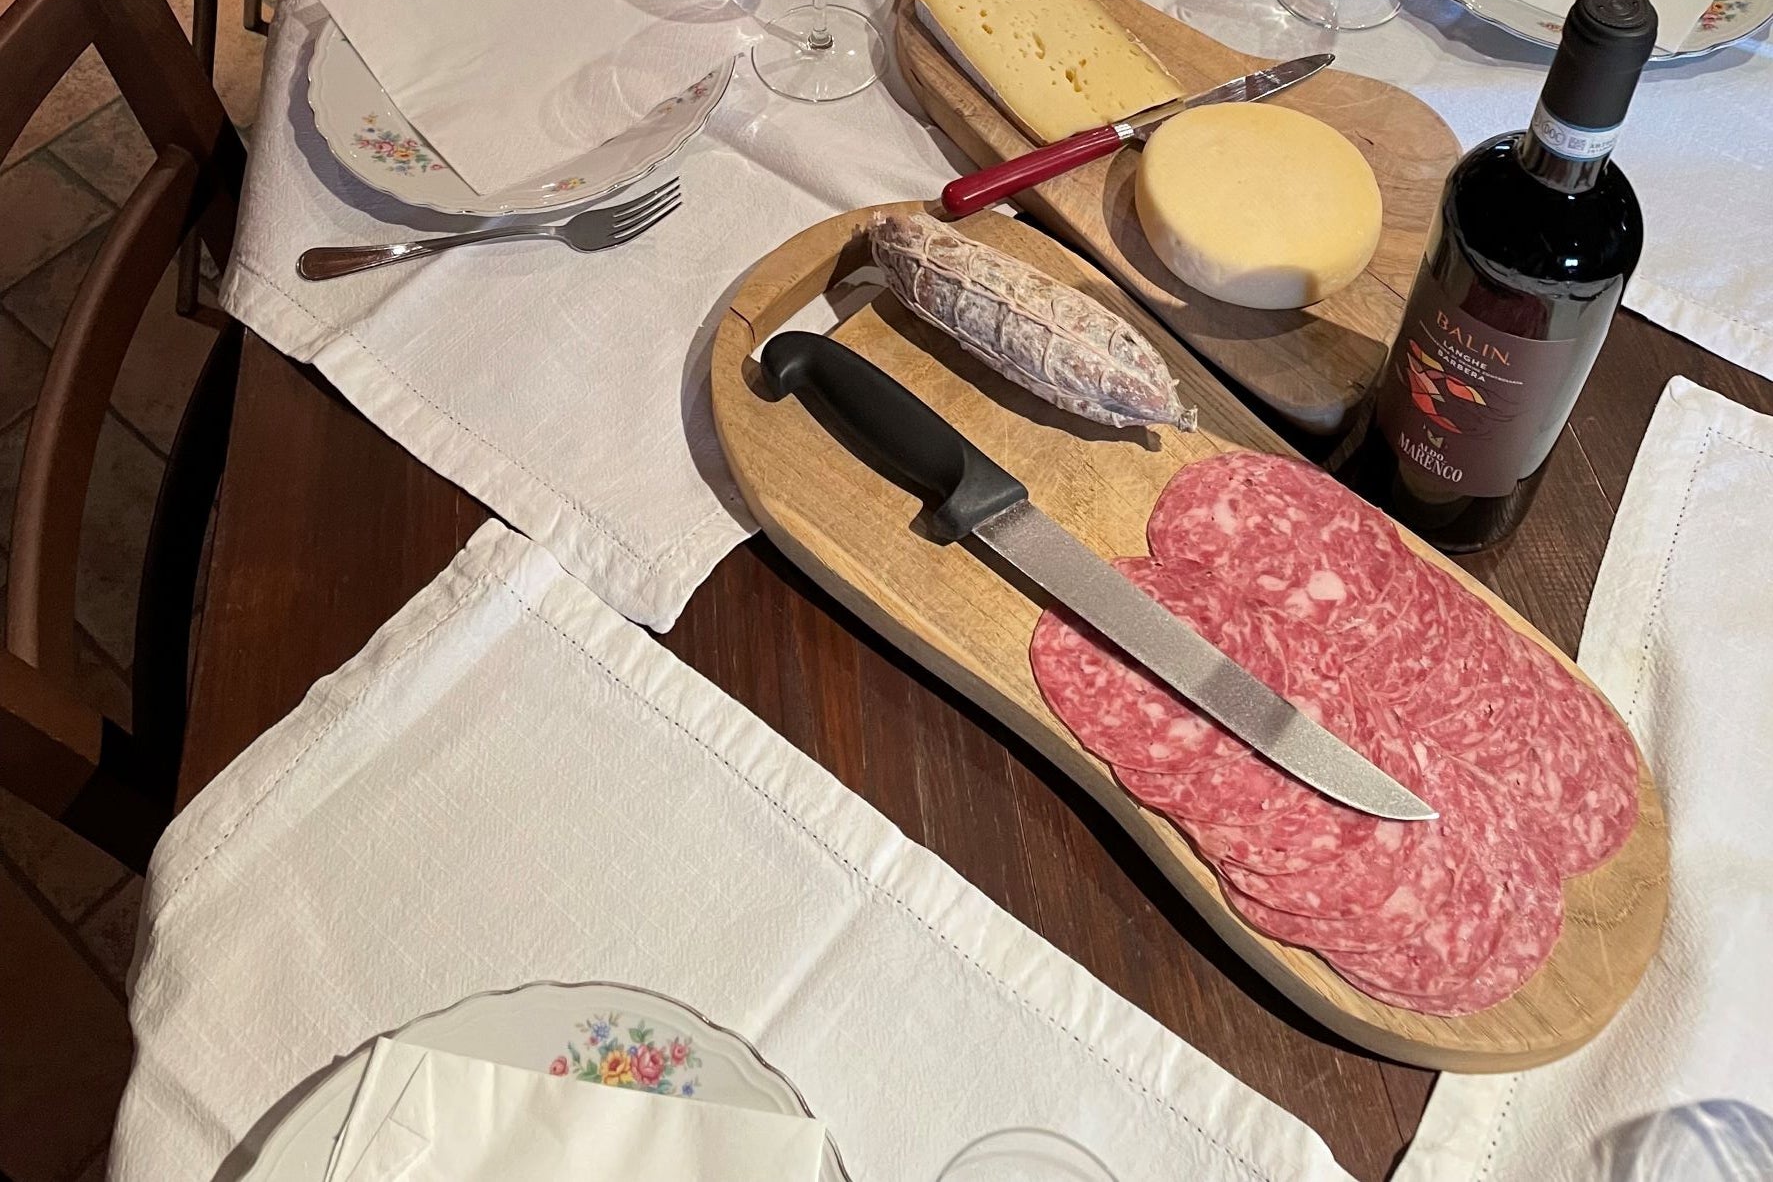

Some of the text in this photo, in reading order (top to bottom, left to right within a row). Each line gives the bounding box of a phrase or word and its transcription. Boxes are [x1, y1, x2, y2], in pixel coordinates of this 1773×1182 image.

[1544, 122, 1565, 144] DOC
[1437, 310, 1510, 366] BALIN
[1437, 349, 1486, 382] BARBERA
[1443, 340, 1488, 370] LANGHE
[1398, 431, 1463, 483] MARENCO
[1418, 442, 1445, 462] ALDO
